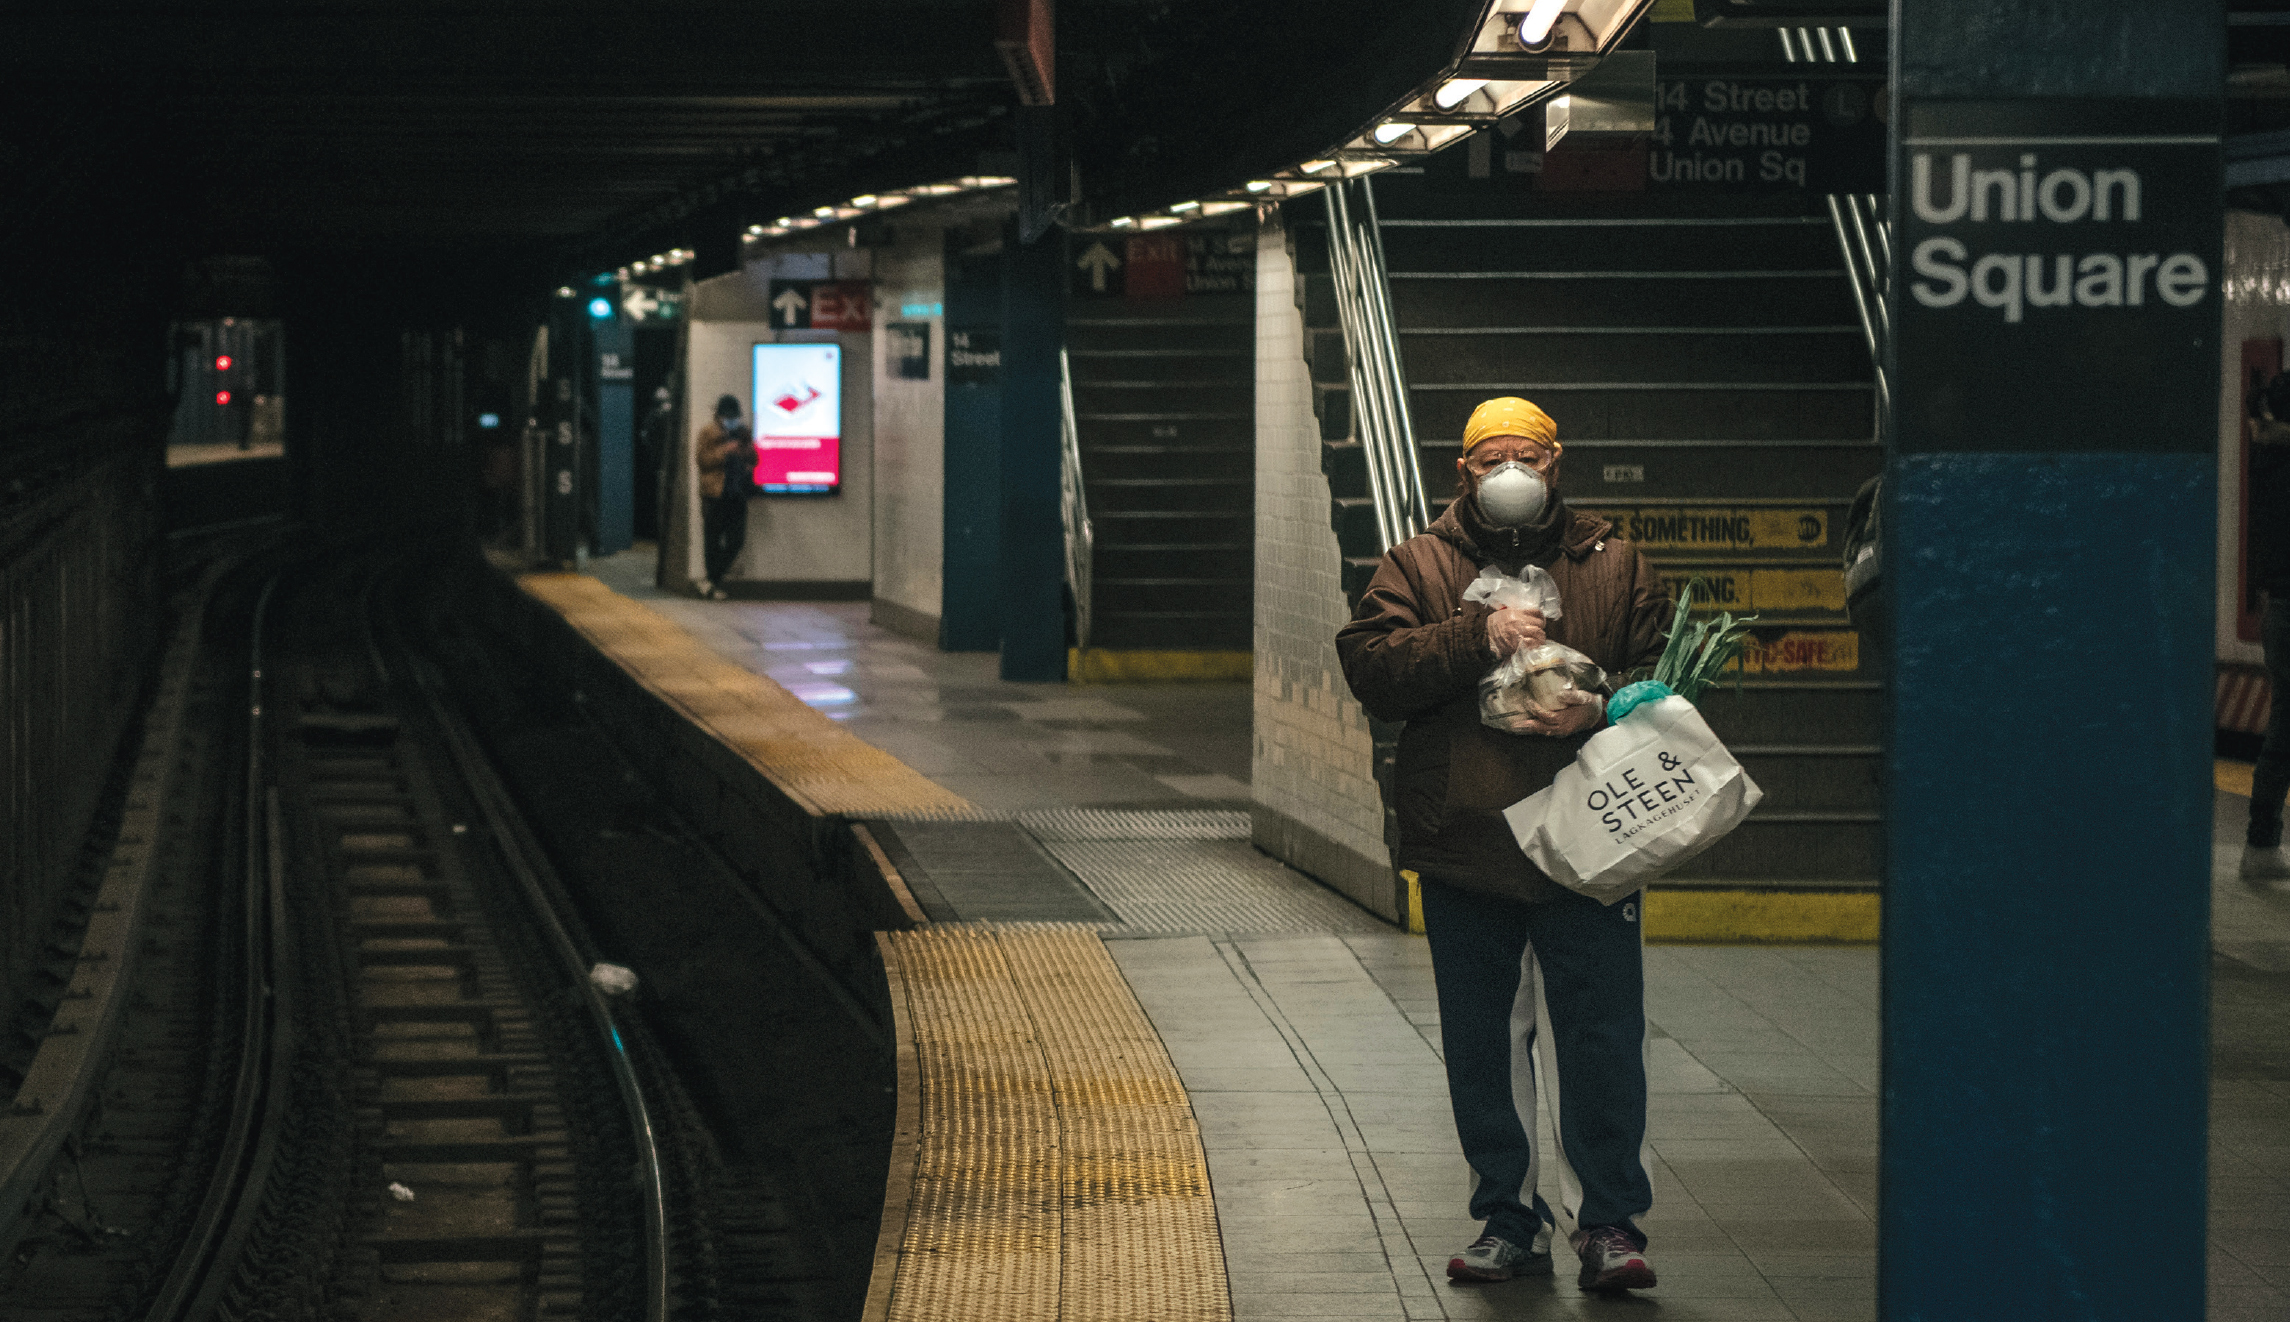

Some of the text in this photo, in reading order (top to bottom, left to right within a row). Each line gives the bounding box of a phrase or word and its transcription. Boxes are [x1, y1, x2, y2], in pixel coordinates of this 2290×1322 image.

[1655, 82, 1688, 111] 14
[1704, 80, 1810, 112] Street
[1650, 117, 1811, 147] 4 Avenue
[1649, 151, 1807, 186] Union Sq
[1912, 153, 2142, 224] Union
[1910, 236, 2209, 323] Square
[1629, 515, 1754, 545] SOMETHING,
[1587, 751, 1682, 811] OLE &
[1602, 768, 1695, 833] STEEN
[1615, 788, 1701, 845] LAGKAGEHUSET
